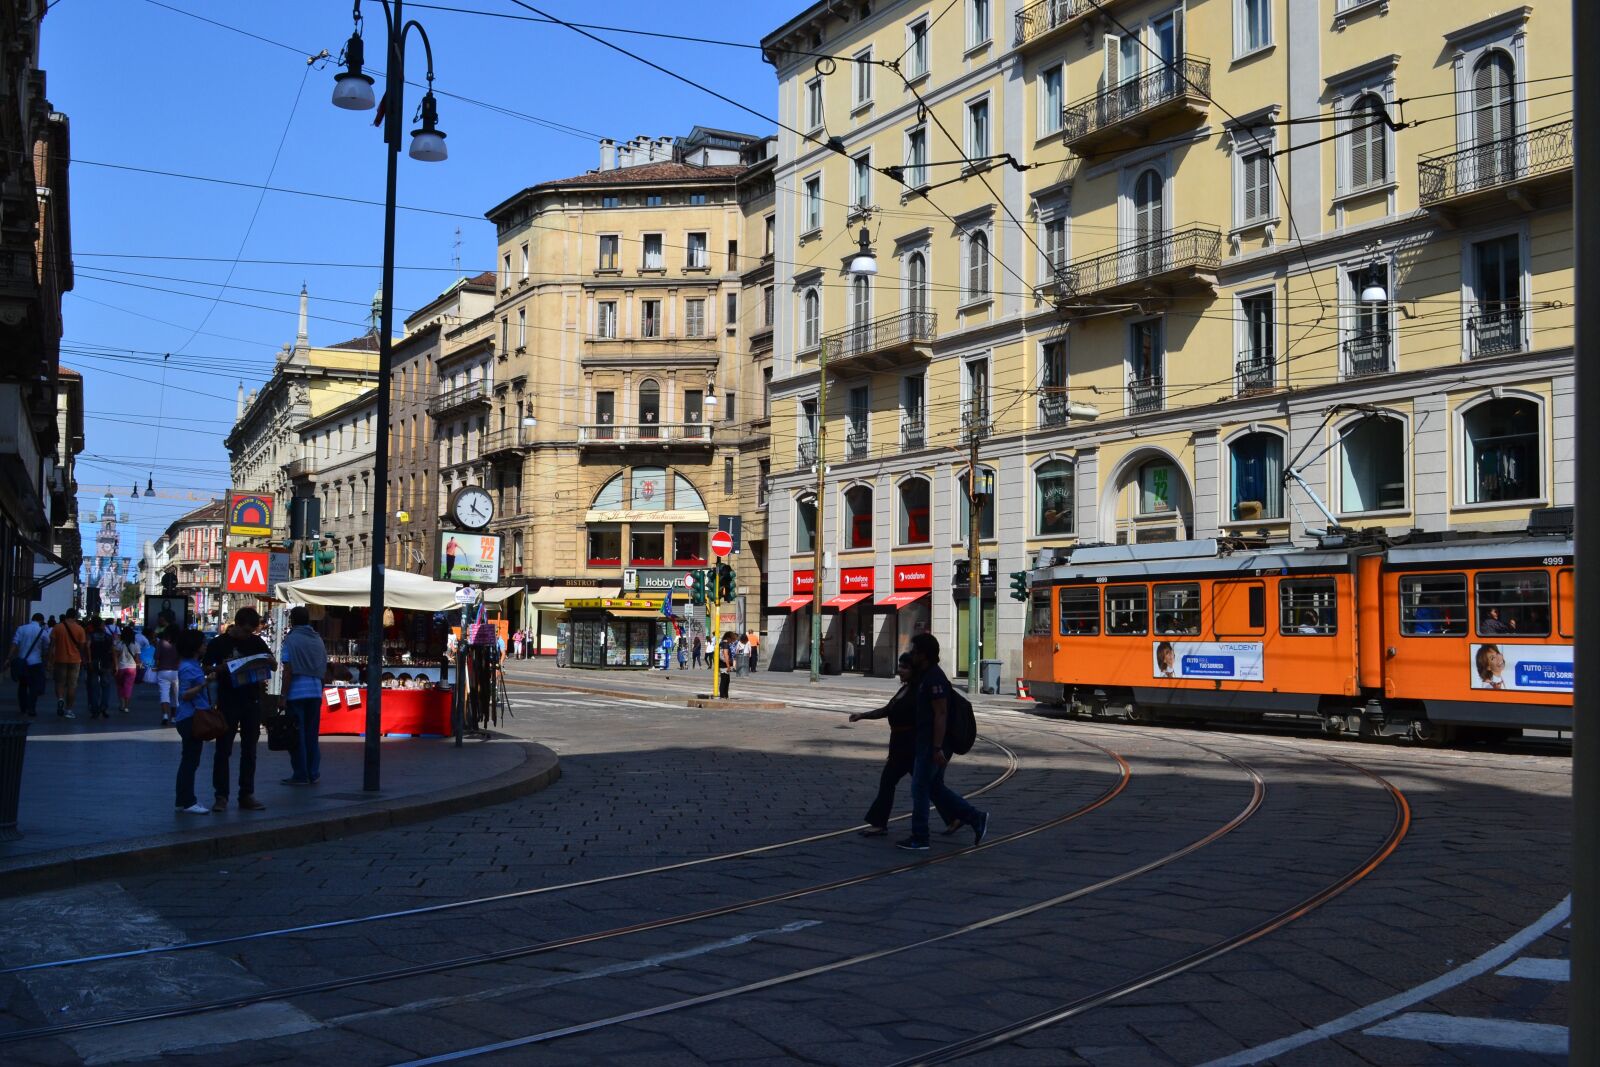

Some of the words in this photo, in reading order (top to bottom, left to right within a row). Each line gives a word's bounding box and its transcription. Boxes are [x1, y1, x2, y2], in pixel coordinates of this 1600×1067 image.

[1154, 482, 1168, 501] 72
[480, 536, 495, 546] PAR
[481, 546, 494, 560] 72
[1542, 556, 1564, 566] 4999
[230, 559, 265, 585] M
[904, 572, 926, 580] vodafone
[565, 579, 597, 587] BISTROT
[849, 576, 869, 584] vodafone
[1544, 671, 1556, 679] TUO
